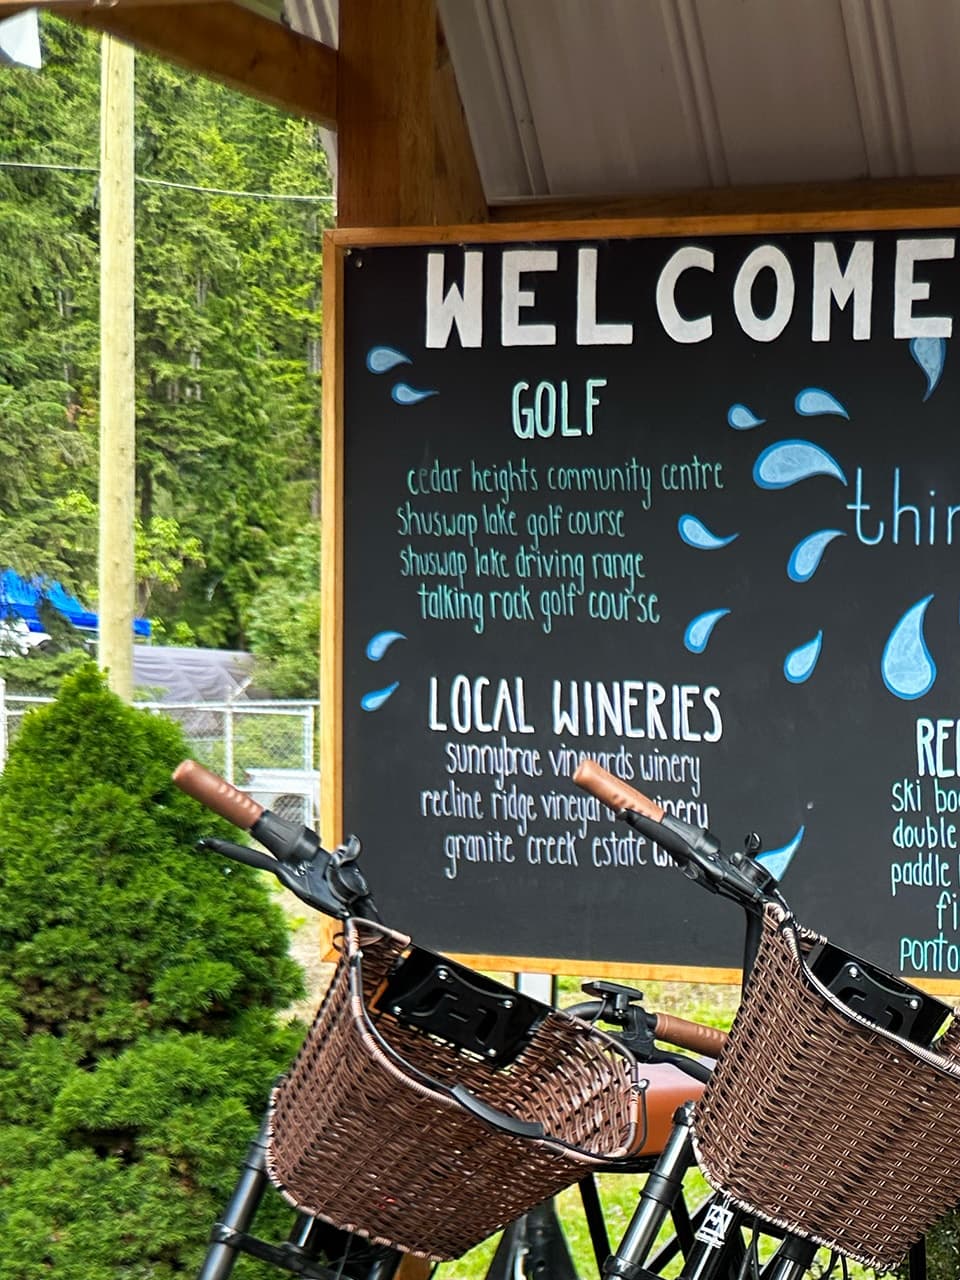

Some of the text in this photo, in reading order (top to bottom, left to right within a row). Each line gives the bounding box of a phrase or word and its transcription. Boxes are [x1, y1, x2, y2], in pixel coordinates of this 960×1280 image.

[425, 237, 956, 350] WELCOME
[511, 378, 608, 440] GOLF
[406, 455, 724, 510] cedar heights community centre
[397, 502, 626, 550] shuswap lake golf course
[400, 545, 646, 596] shuswap lake driving range
[417, 582, 661, 635] talking rock golf course
[428, 674, 724, 743] LOCAL WINERIES
[445, 736, 702, 798] sunnybrae vinards winery
[420, 780, 484, 817] recline
[491, 785, 538, 837] ridge
[891, 778, 922, 813] ski
[444, 831, 517, 880] granite
[526, 830, 580, 868] creek
[591, 830, 648, 868] estate
[892, 816, 958, 850] double
[891, 852, 952, 896] paddle
